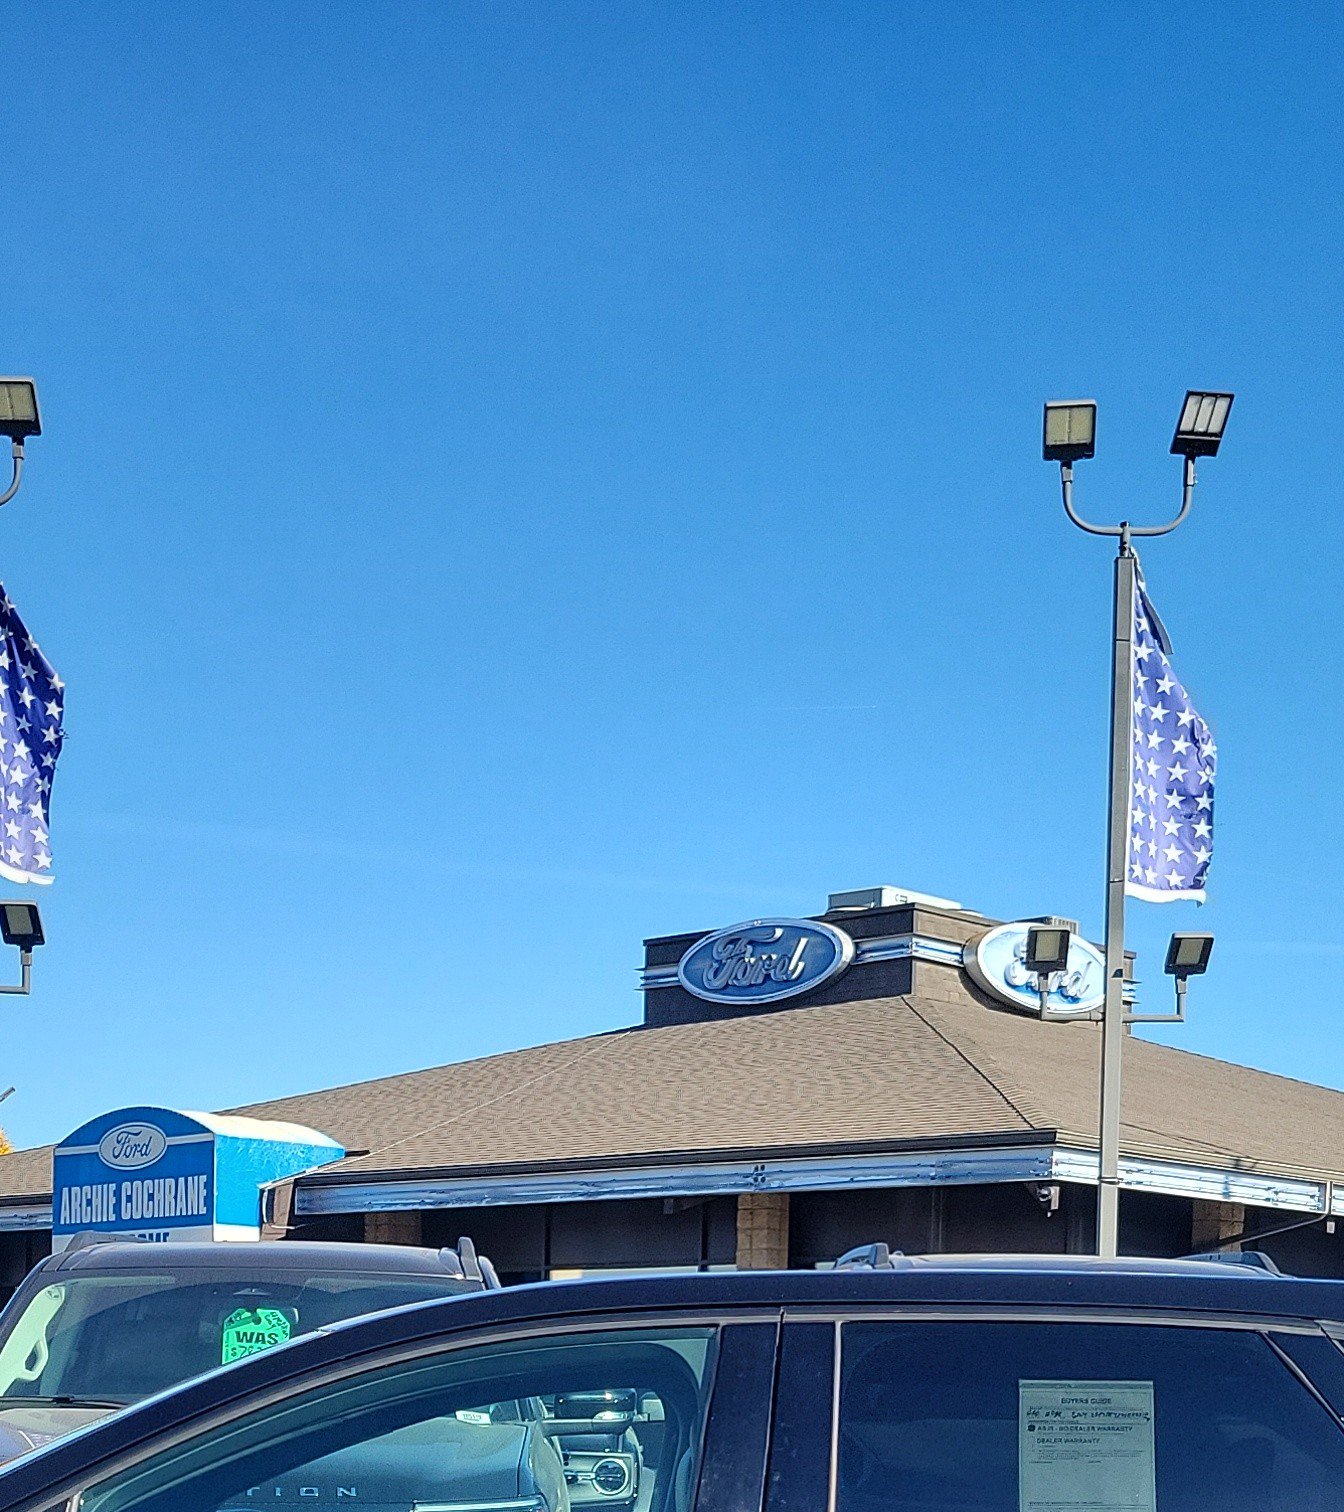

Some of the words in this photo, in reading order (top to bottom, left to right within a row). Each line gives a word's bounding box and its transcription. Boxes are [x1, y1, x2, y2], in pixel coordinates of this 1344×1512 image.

[703, 927, 809, 990] Ford
[112, 1130, 153, 1159] Ford
[60, 1183, 117, 1225] ARCHIE
[121, 1174, 207, 1220] COCHRANE
[235, 1331, 278, 1345] WAS
